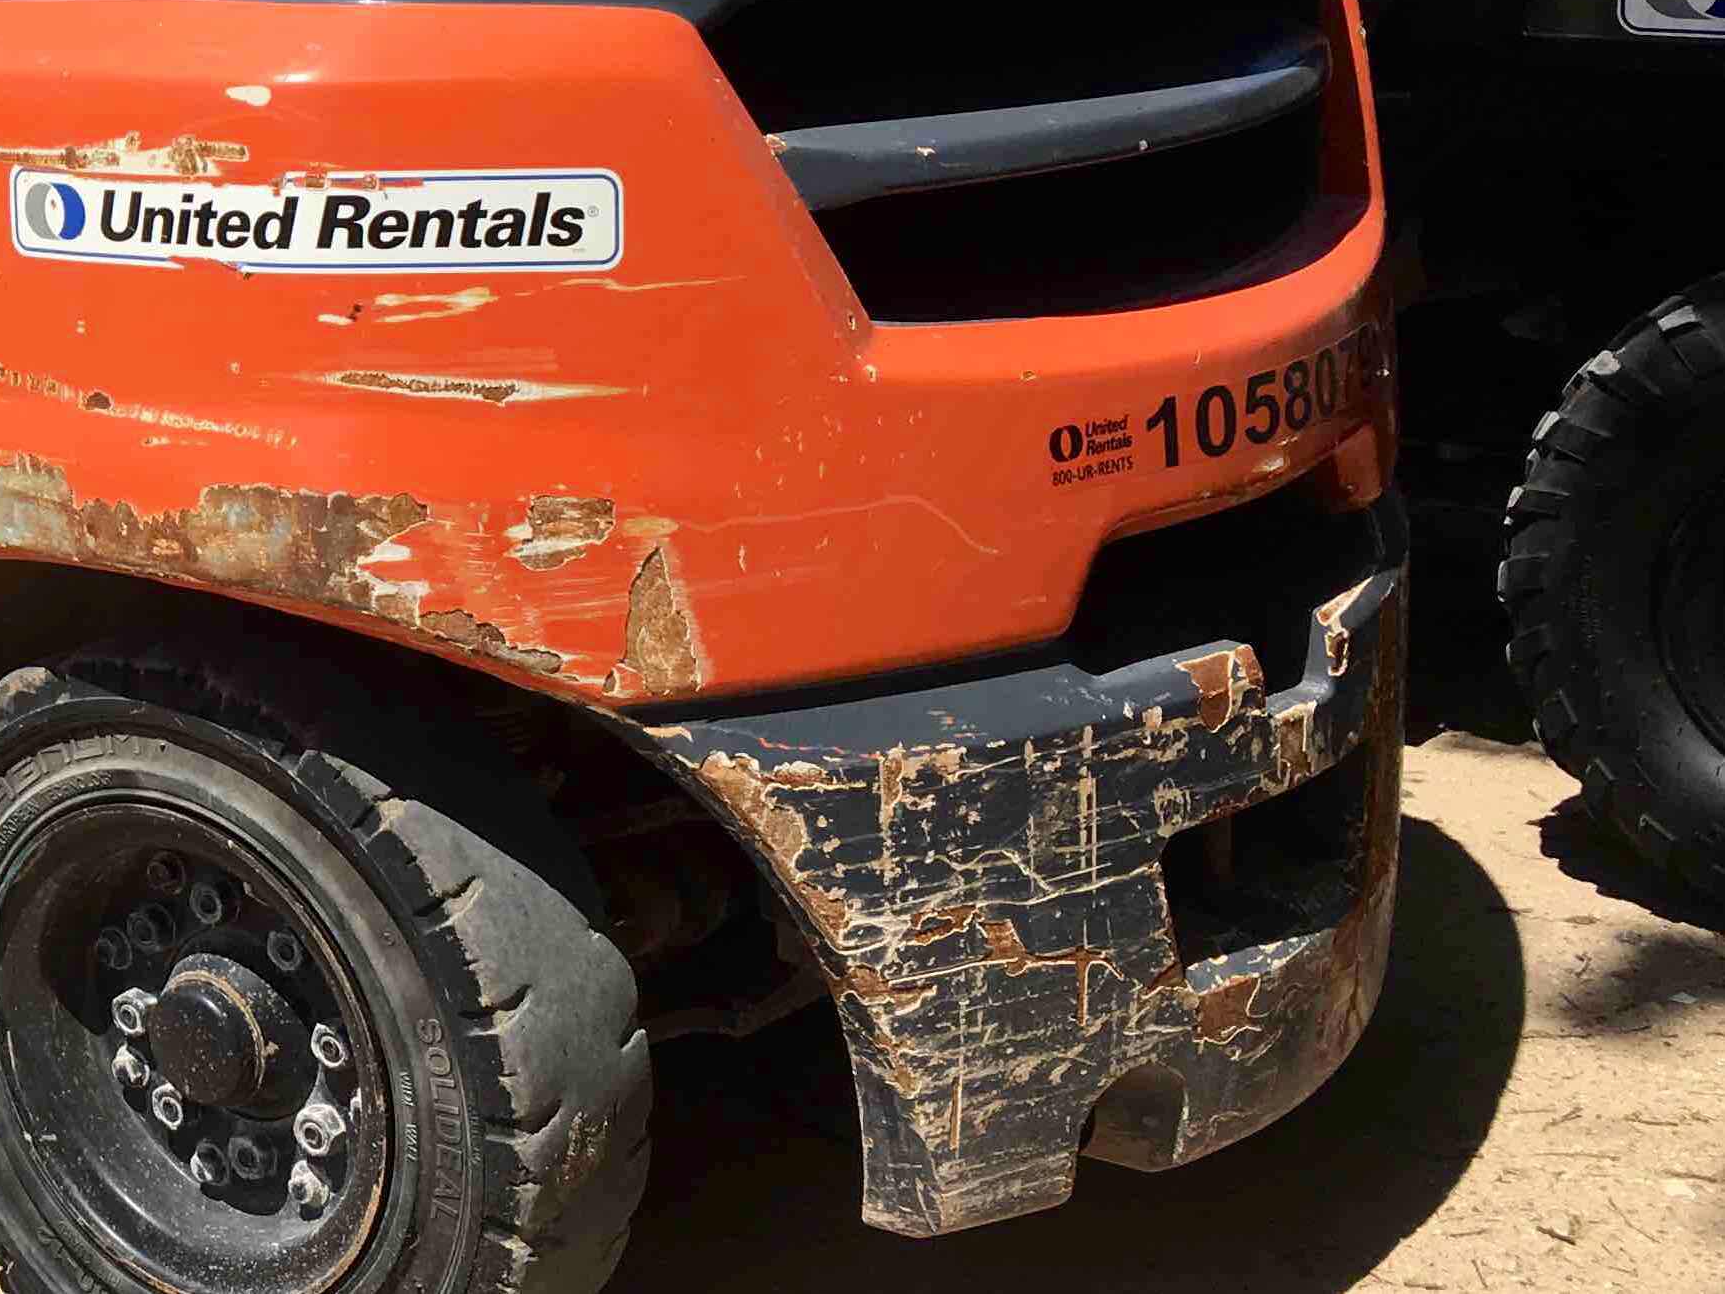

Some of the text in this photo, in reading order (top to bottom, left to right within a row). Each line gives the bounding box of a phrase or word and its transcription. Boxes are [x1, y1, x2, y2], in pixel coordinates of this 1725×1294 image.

[101, 190, 585, 250] United Rentals
[1085, 413, 1129, 439] United
[1086, 432, 1133, 458] Rentals
[1051, 455, 1134, 487] 800-UR-RENTS
[416, 1016, 467, 1221] SOLIDEAL
